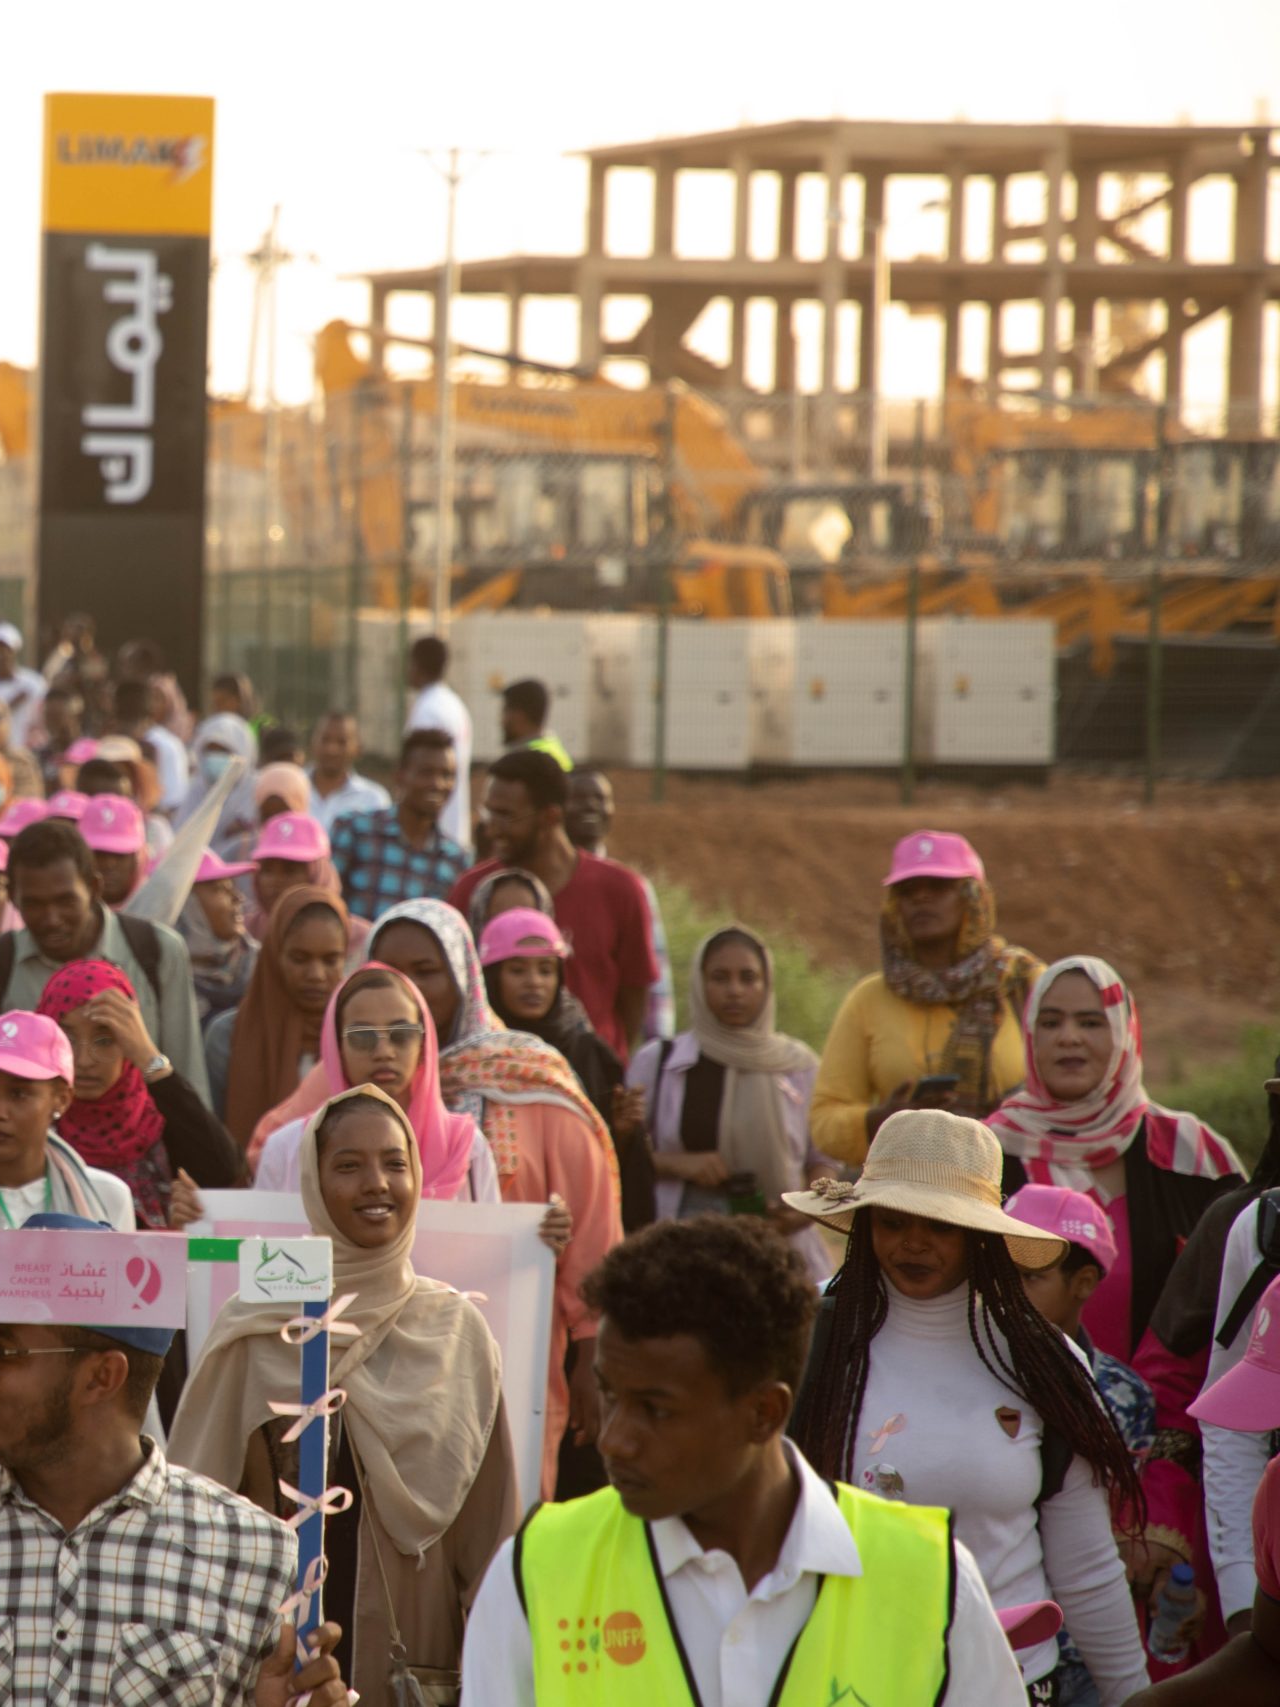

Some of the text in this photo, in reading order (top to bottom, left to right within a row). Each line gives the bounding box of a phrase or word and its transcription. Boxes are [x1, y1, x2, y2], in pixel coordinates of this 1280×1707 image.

[82, 243, 172, 502] ليماك
[14, 1264, 53, 1273] BREAST
[9, 1277, 51, 1286] CANCER
